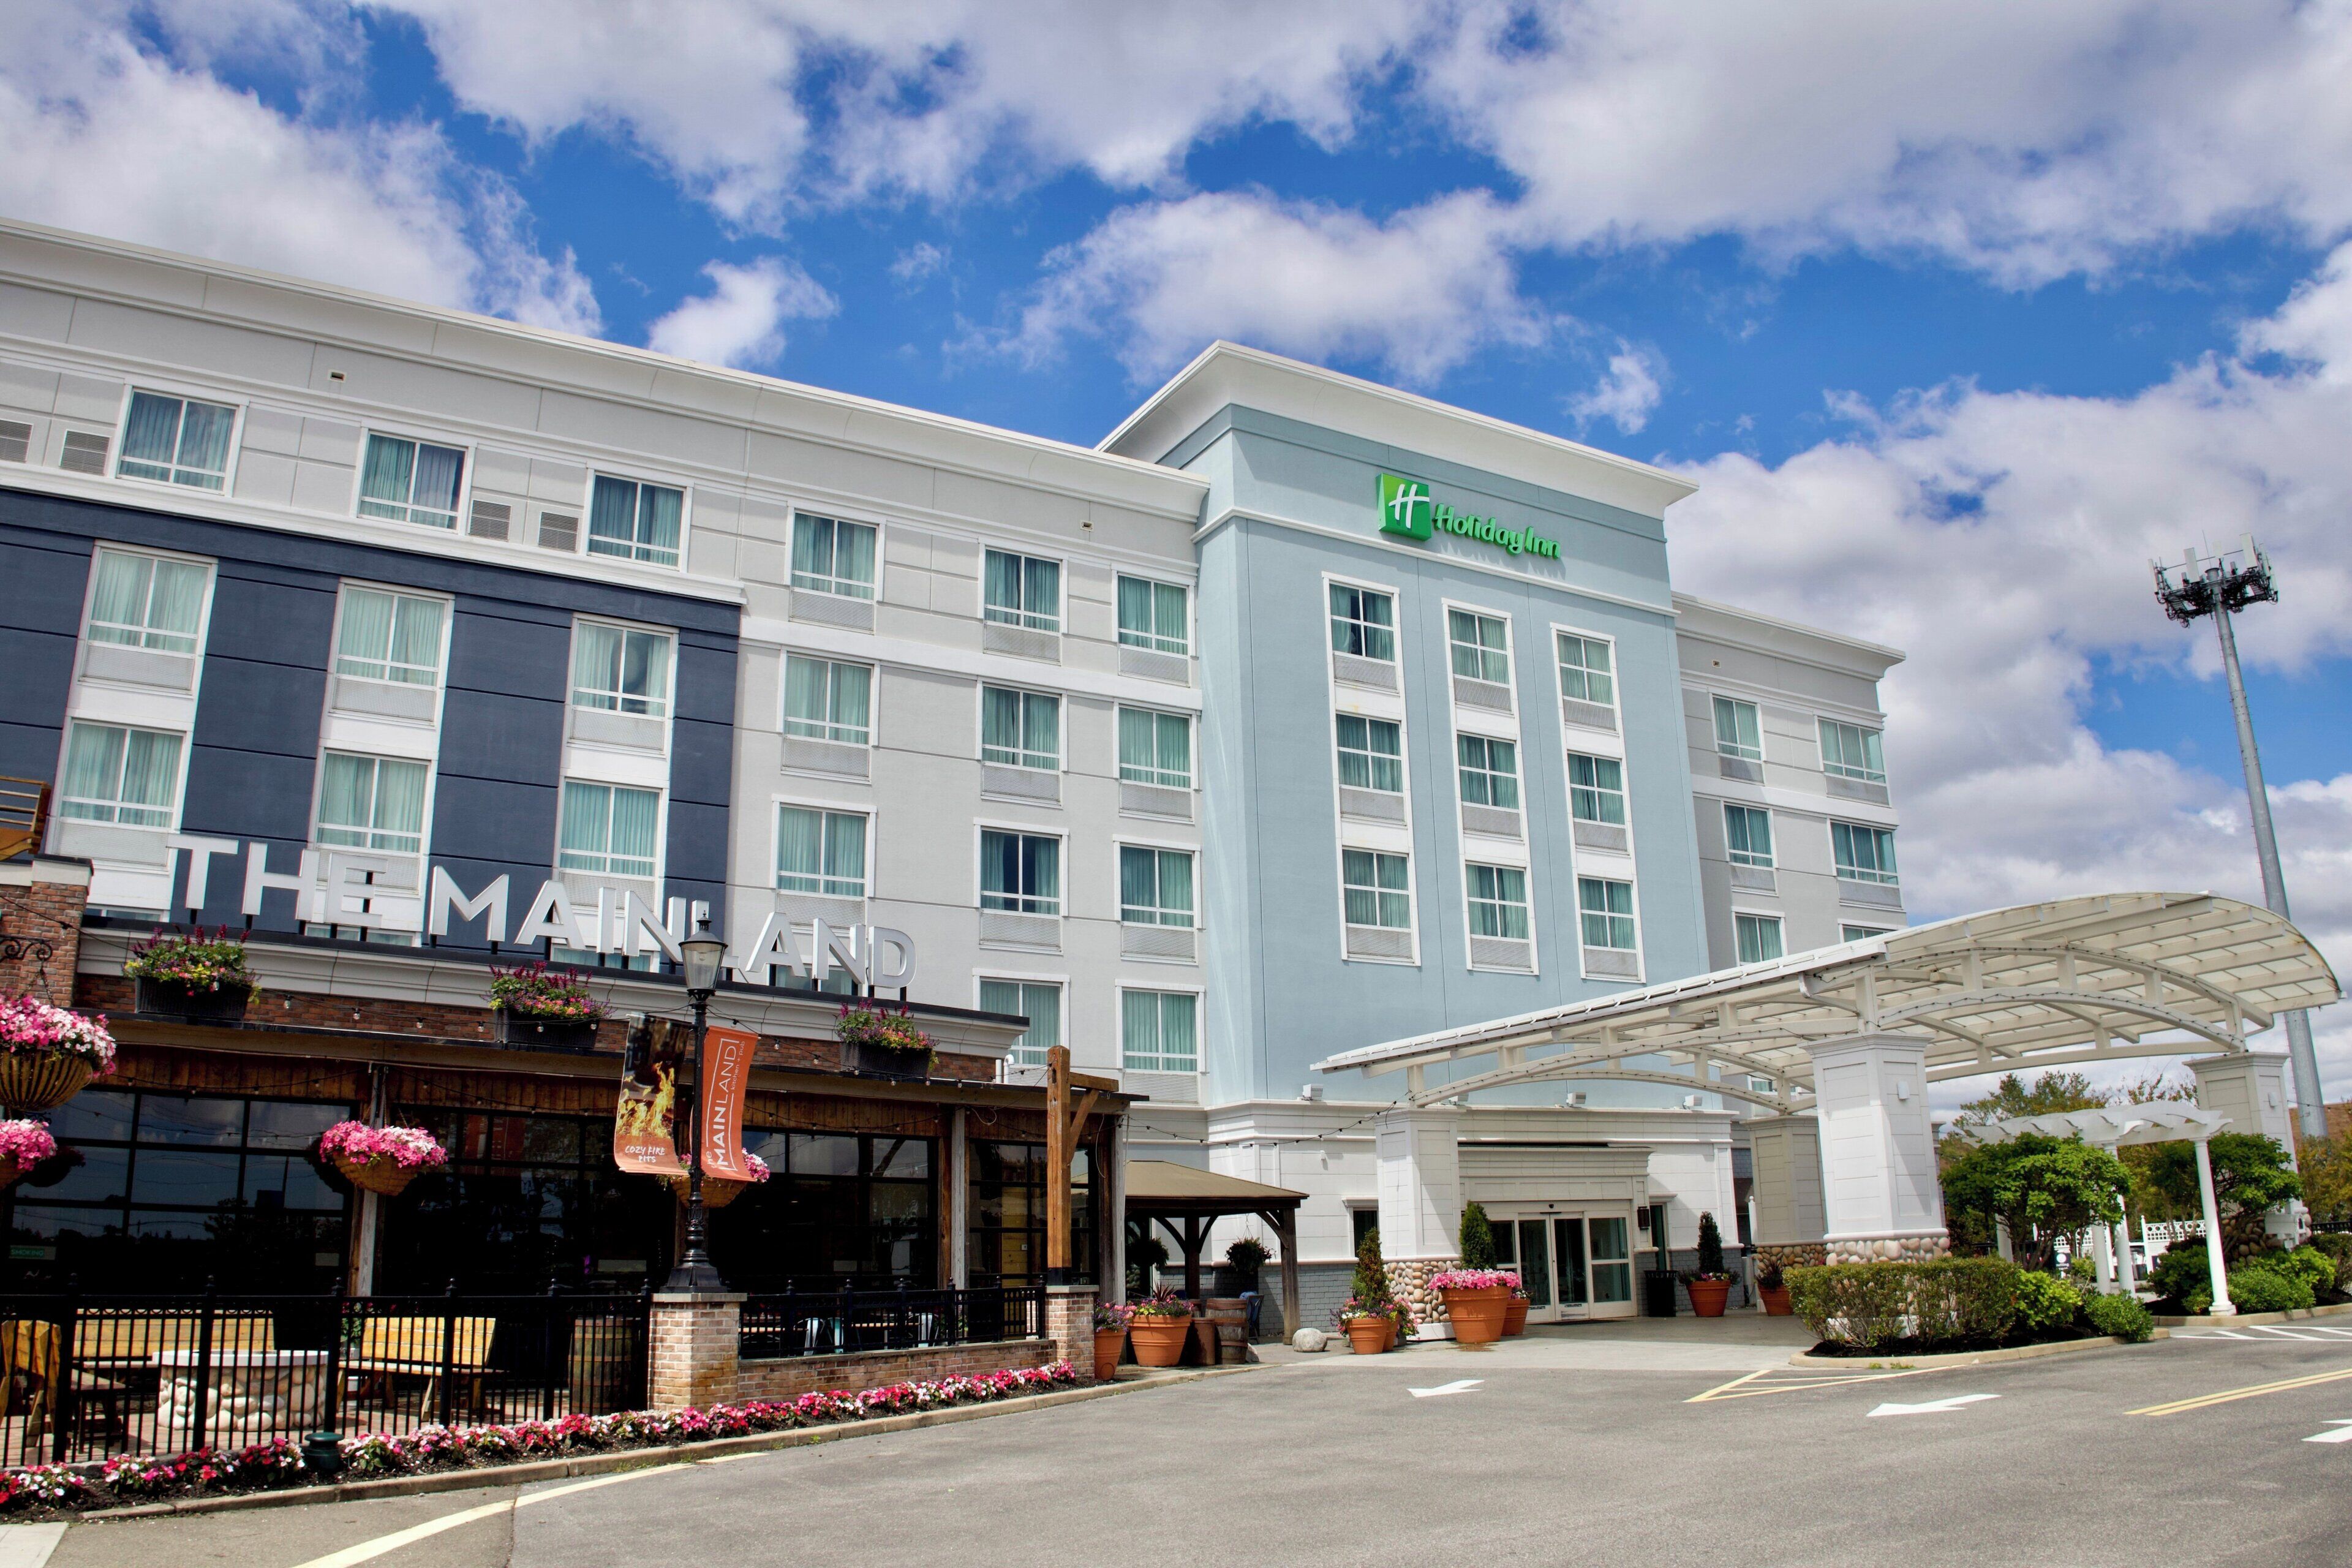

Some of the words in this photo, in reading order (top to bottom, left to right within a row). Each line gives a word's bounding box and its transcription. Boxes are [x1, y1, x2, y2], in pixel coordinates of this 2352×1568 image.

[1432, 503, 1523, 554] Holiday
[1525, 526, 1561, 559] Inn
[166, 833, 388, 928] THE
[731, 1064, 740, 1090] kitchen
[713, 1046, 736, 1166] MAINLAND
[625, 1145, 646, 1155] COZY
[647, 1146, 666, 1156] FIRE
